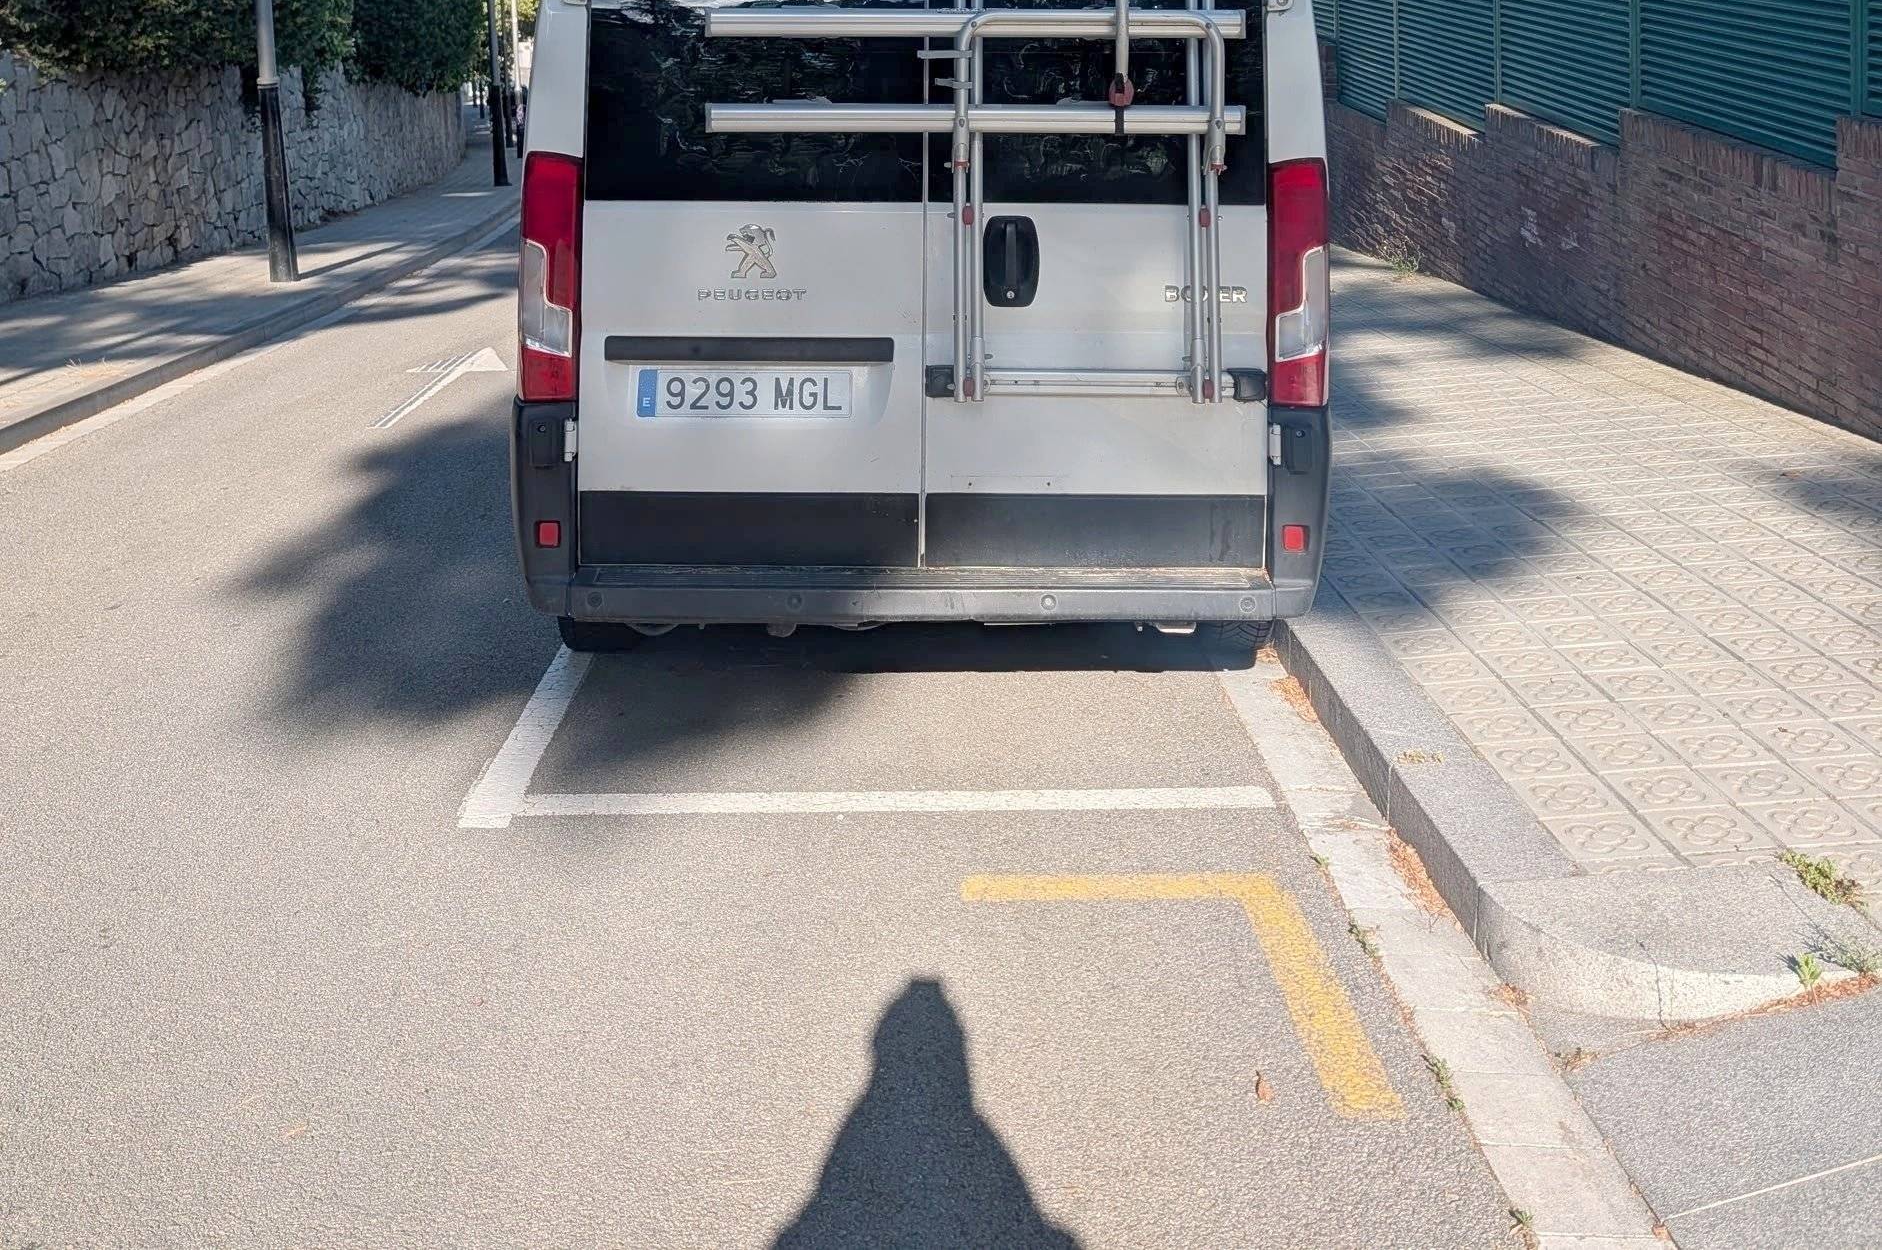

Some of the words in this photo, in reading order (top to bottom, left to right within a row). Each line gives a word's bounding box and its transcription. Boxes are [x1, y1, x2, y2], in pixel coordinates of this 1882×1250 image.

[697, 288, 807, 301] PEUGEOT
[1164, 285, 1248, 303] BOER
[666, 376, 758, 410] 9293
[773, 377, 843, 410] MGL
[643, 397, 651, 407] E
